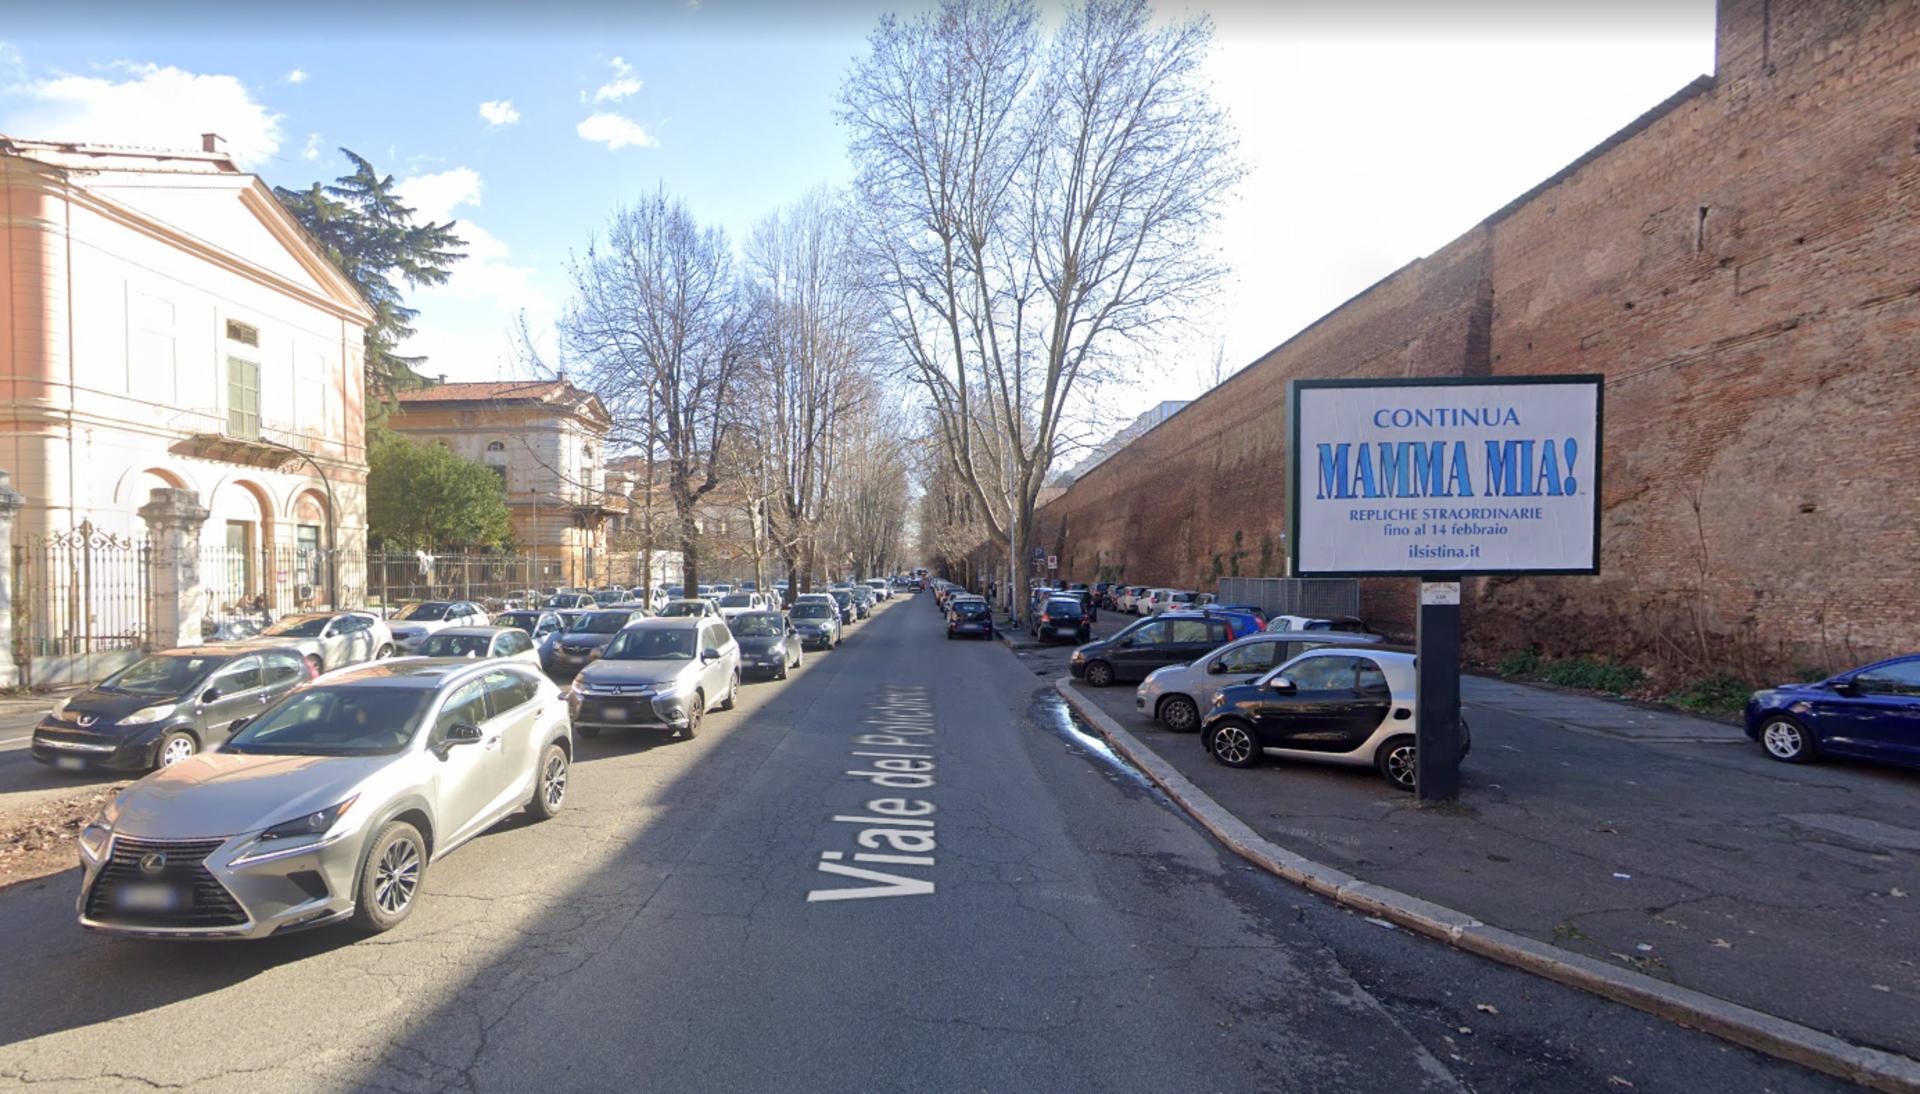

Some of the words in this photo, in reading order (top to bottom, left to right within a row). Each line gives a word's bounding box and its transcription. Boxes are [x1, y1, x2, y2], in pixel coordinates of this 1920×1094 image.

[1373, 407, 1521, 428] CONTINUA
[1316, 441, 1475, 500] MAMMA
[1484, 437, 1579, 497] MIA!
[1350, 509, 1417, 521] REPLICHE
[1422, 507, 1543, 520] STRAORDINARIE
[1383, 523, 1410, 536] fino
[1414, 523, 1426, 536] al
[1432, 524, 1447, 536] 14
[1451, 522, 1508, 536] febbraio
[1408, 545, 1480, 559] ilsistina.it
